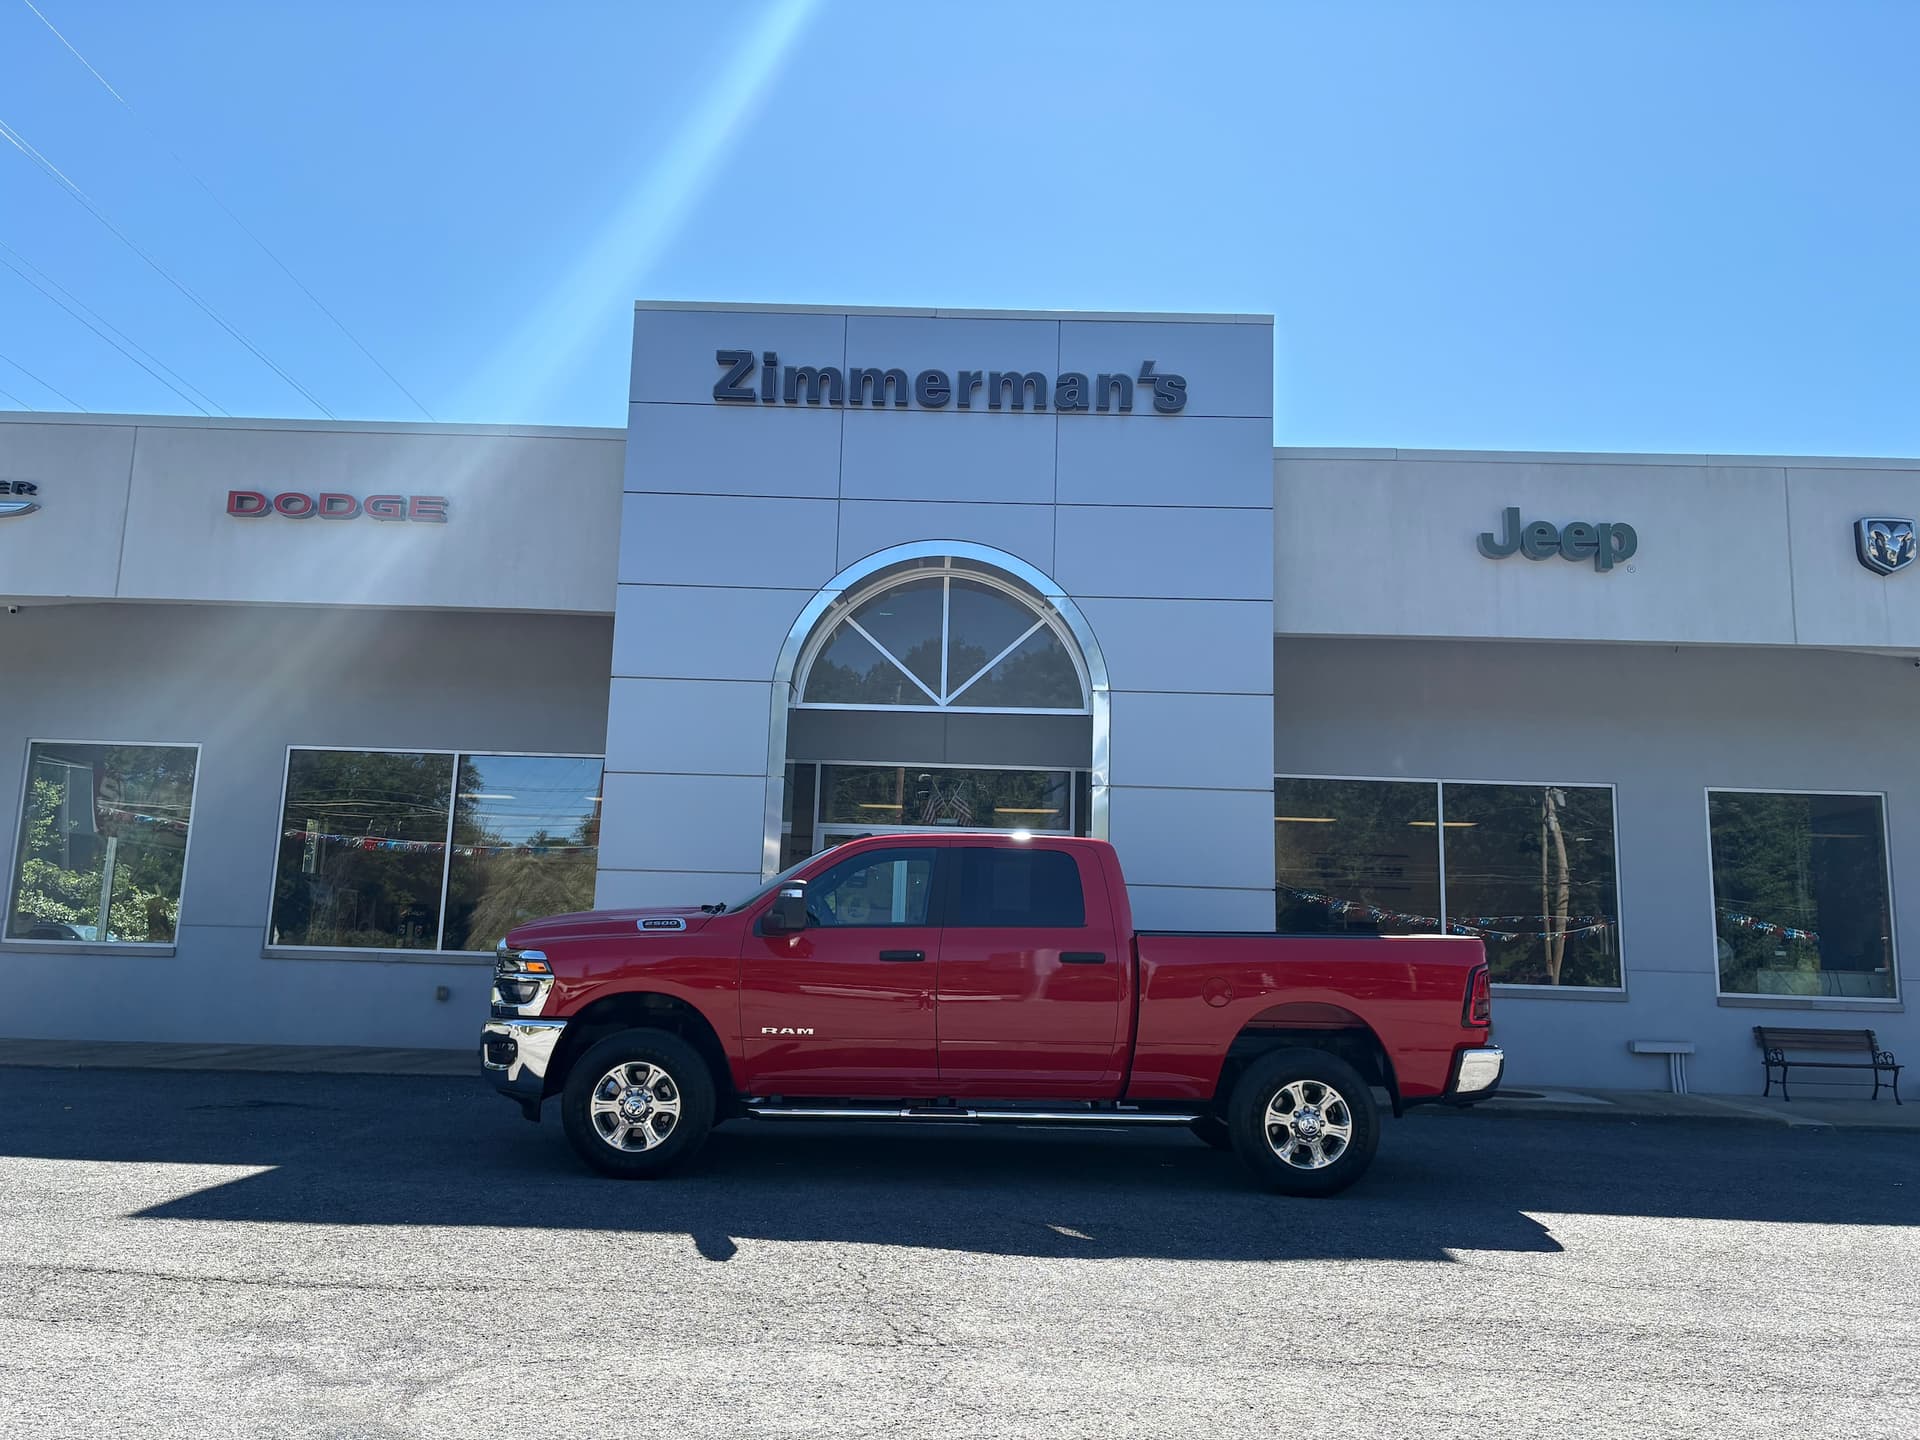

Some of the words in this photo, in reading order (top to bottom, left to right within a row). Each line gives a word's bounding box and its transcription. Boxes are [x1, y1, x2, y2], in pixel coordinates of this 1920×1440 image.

[712, 349, 1189, 414] Zimmerman's
[226, 490, 449, 523] DODGE
[1476, 506, 1638, 573] Jeep
[761, 1027, 814, 1035] RAM
